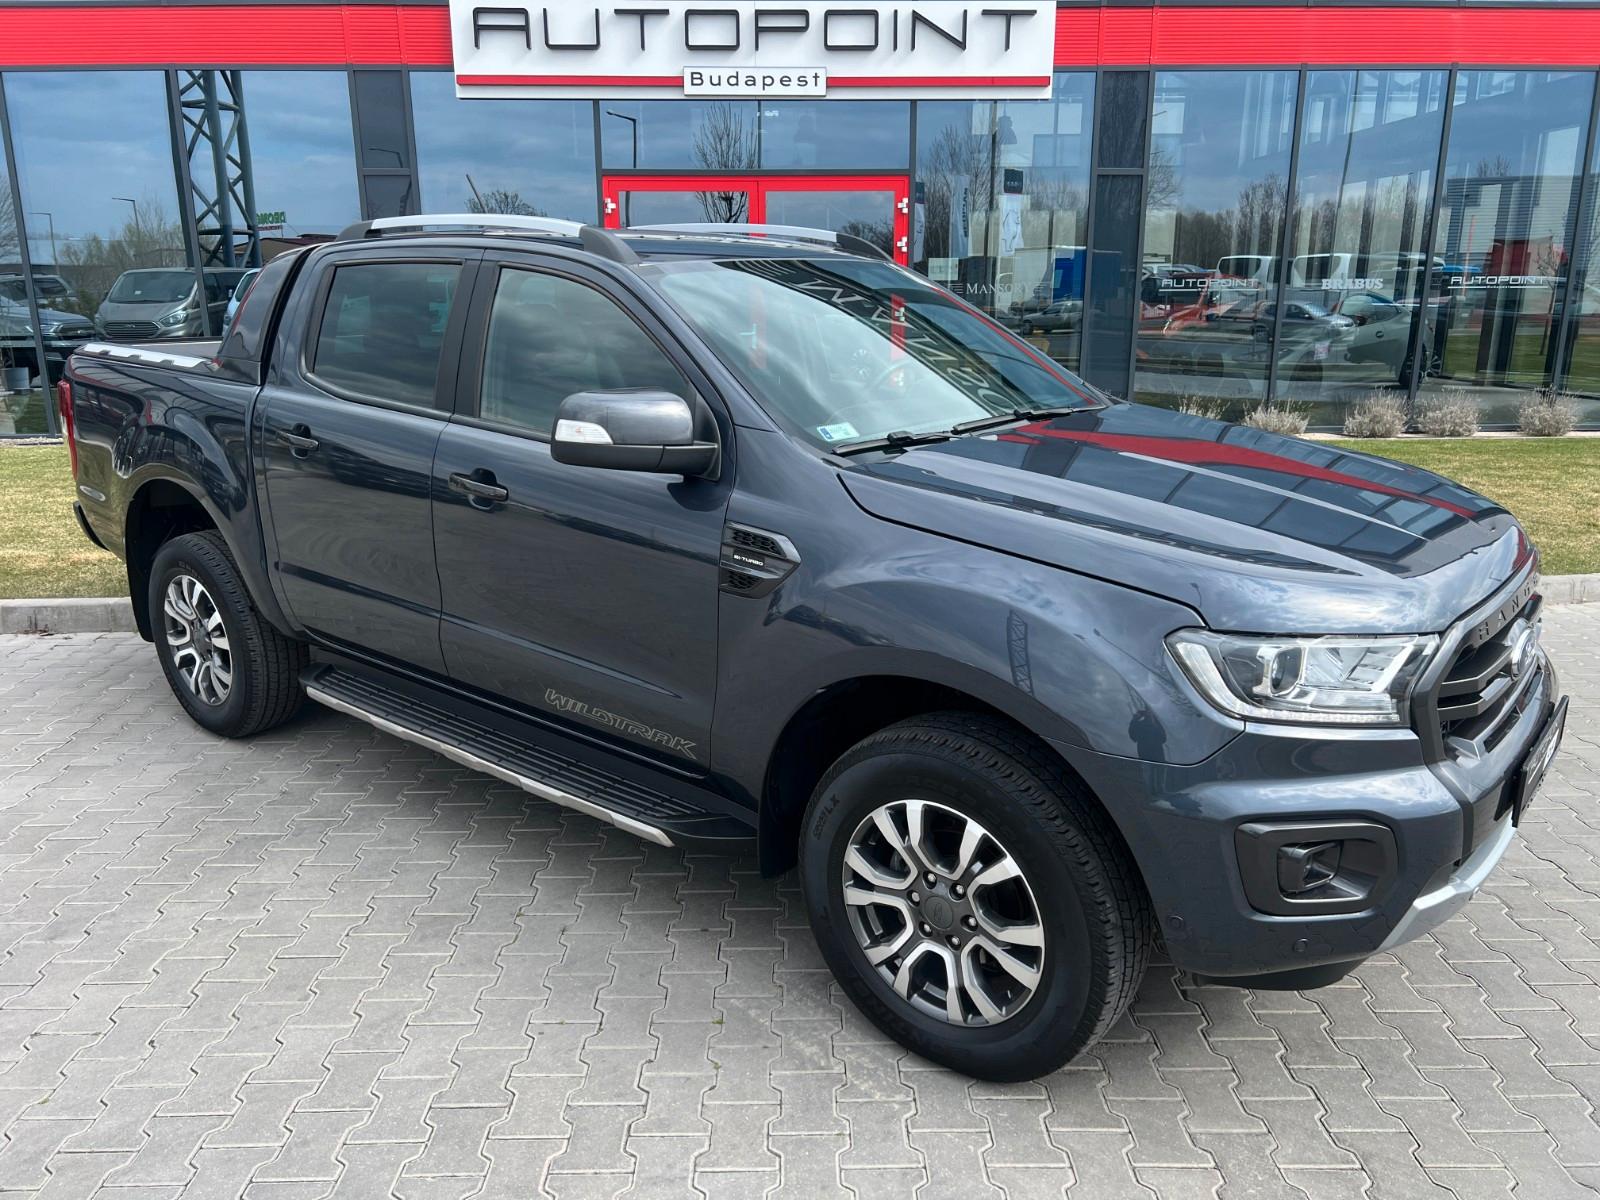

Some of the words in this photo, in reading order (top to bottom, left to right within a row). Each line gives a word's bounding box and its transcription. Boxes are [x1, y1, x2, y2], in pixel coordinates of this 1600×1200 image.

[473, 7, 1037, 51] AUTOPOINT
[690, 71, 820, 91] Budapest
[1161, 278, 1258, 288] AUTOPOINT
[1321, 278, 1384, 290] BRABUS
[1451, 276, 1544, 285] AUTOPOINT
[544, 688, 698, 760] WILDTRAK
